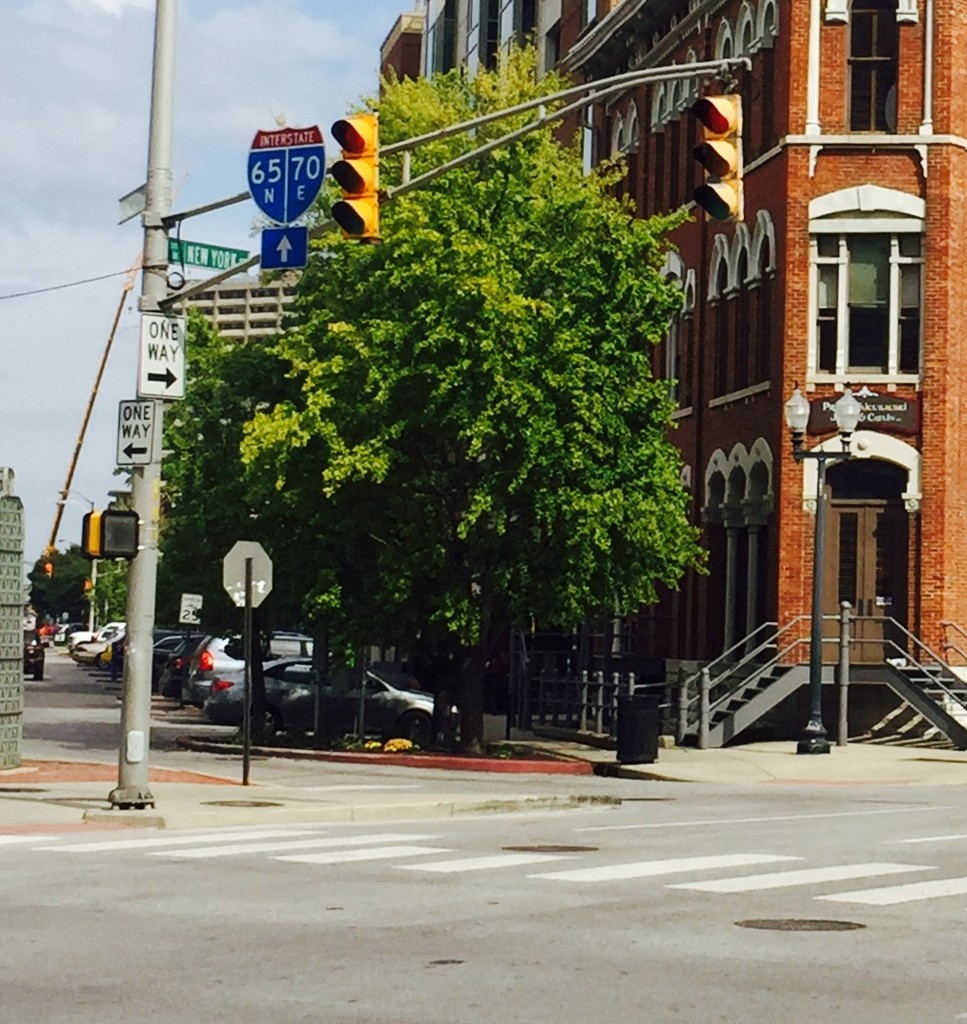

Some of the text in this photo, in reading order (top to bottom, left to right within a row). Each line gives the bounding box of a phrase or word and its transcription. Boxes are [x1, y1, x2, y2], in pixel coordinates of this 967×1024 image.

[259, 130, 315, 148] INTERSTATE
[251, 155, 321, 184] 65 70
[264, 185, 306, 203] N E
[187, 245, 209, 265] NEW
[211, 249, 238, 269] YORK
[149, 321, 179, 341] ONE
[147, 343, 180, 362] WAY
[123, 405, 151, 421] ONE
[122, 423, 151, 438] WAY
